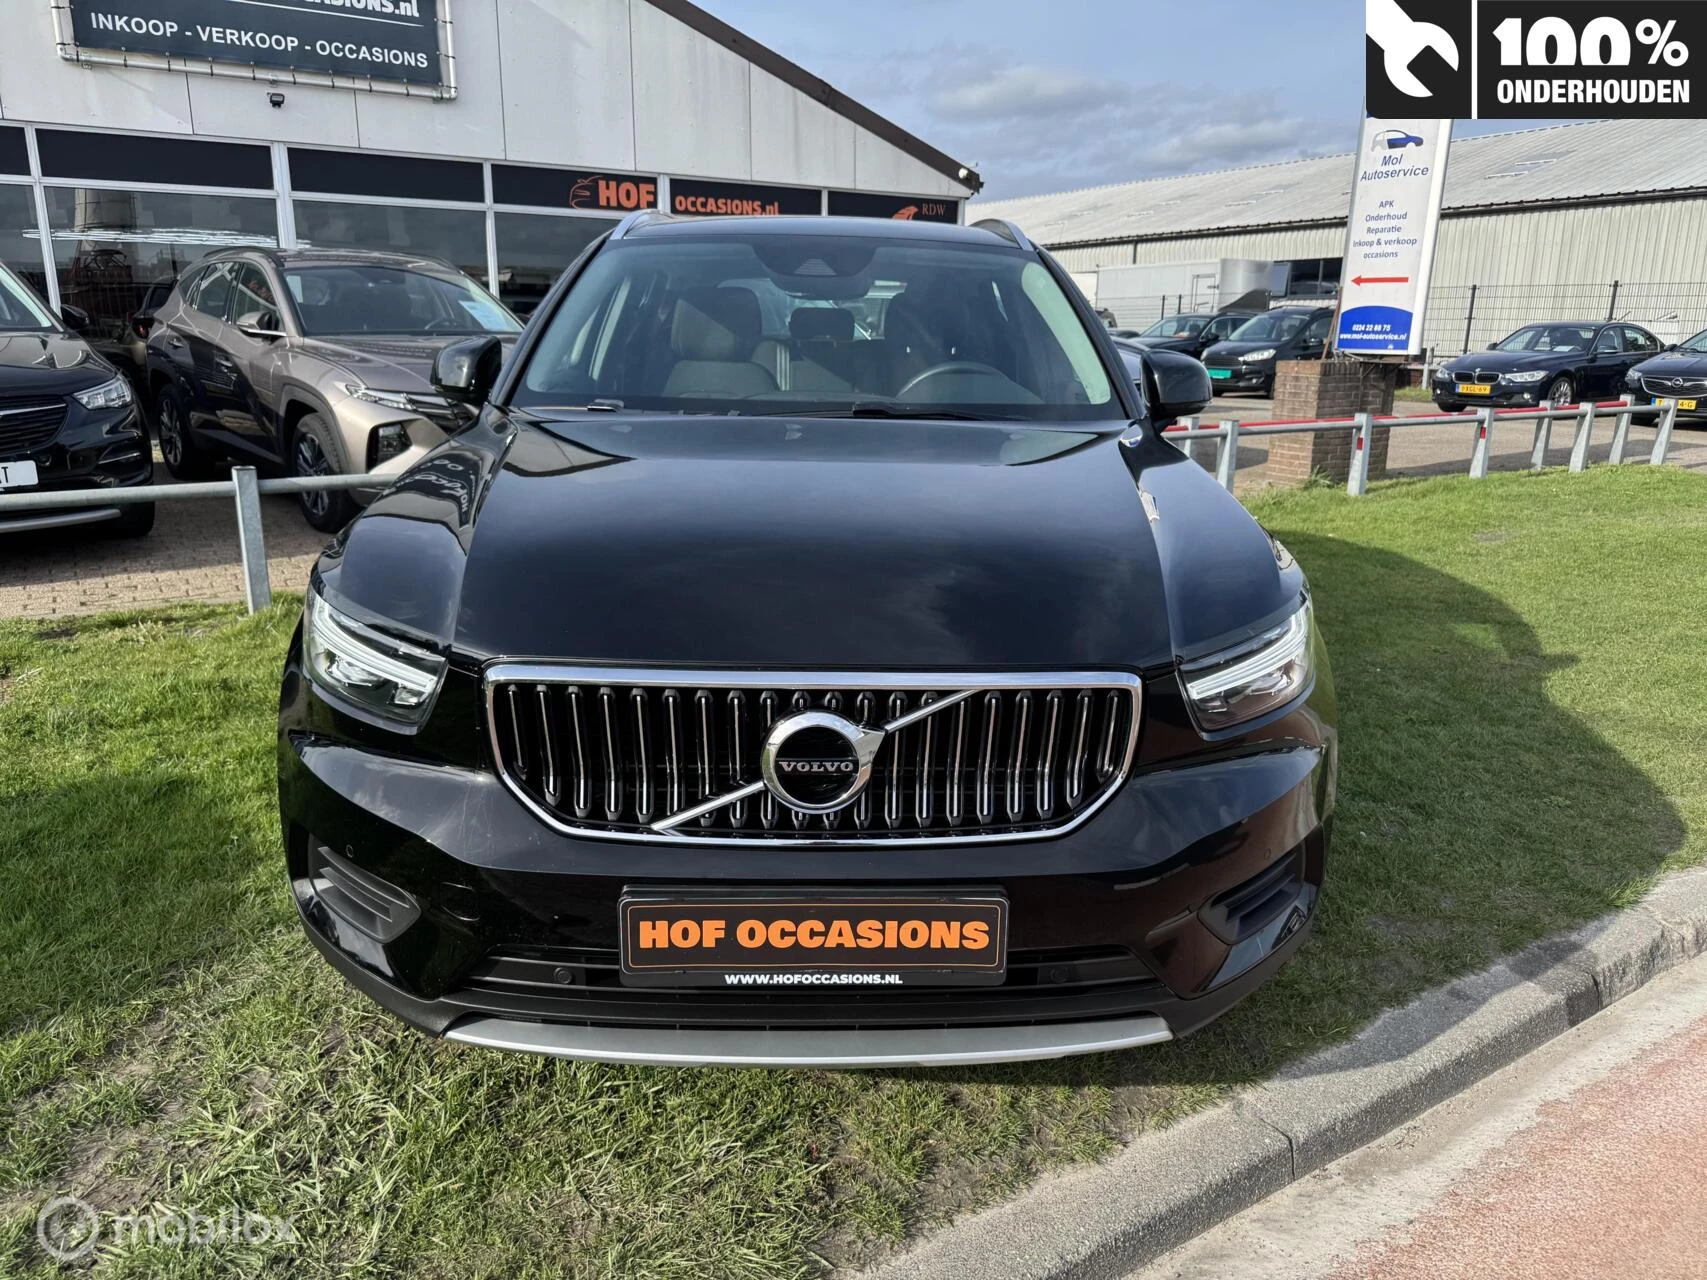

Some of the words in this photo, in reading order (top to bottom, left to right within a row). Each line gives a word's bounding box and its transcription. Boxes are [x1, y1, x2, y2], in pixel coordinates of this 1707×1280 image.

[90, 12, 178, 38] INKOOP
[196, 25, 299, 53] VERKOOP
[315, 41, 429, 69] OCCASIONS
[1381, 154, 1404, 166] Mol
[1360, 165, 1429, 182] Autoservice
[598, 180, 655, 209] HOF
[675, 195, 779, 216] OCCASIONS.nl
[922, 203, 946, 216] RDW
[1379, 200, 1395, 209] APK
[1365, 211, 1408, 222] Onderhoud
[1366, 224, 1402, 235] Reparatie
[1376, 238, 1383, 247] &
[1384, 238, 1418, 249] verkoop
[1363, 250, 1399, 259] occasions
[778, 760, 854, 773] VOLVO
[639, 920, 725, 949] HOF
[736, 920, 990, 950] OCCASIONS
[724, 974, 904, 986] WWW.HOFOCCASIONS.NL
